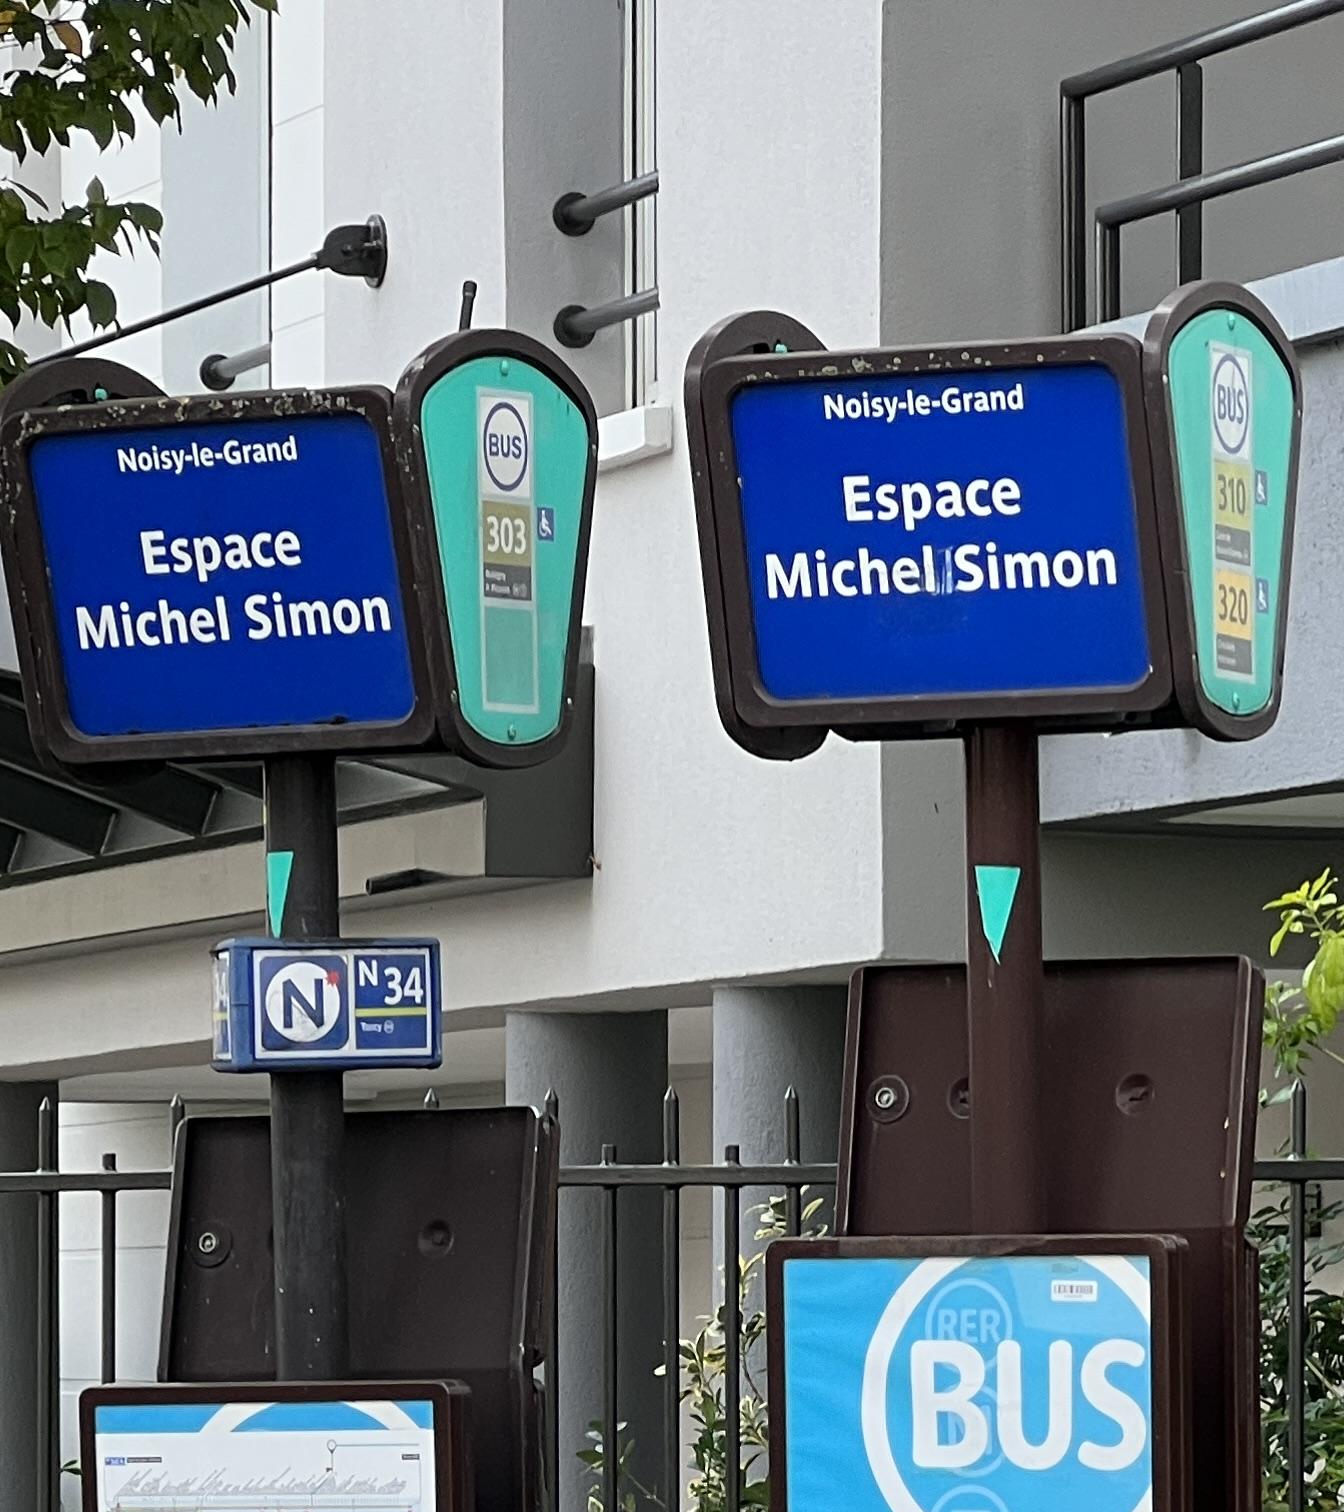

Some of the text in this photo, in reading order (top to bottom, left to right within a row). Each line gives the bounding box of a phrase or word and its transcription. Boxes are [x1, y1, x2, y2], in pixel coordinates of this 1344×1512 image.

[824, 384, 1024, 423] Noisy-le-Grand
[1217, 384, 1244, 424] BUS
[117, 435, 298, 475] Noisy-le-Grand
[489, 433, 522, 460] BUS
[843, 475, 1021, 530] Espace
[1218, 474, 1246, 514] 310
[486, 516, 526, 554] 303
[140, 530, 302, 583] Espace
[765, 542, 1117, 598] Michel Simon
[75, 592, 392, 650] Michel Simon
[1218, 584, 1248, 625] 320
[282, 978, 325, 1029] N
[937, 1308, 1001, 1343] RER
[909, 1339, 1146, 1471] BUS
